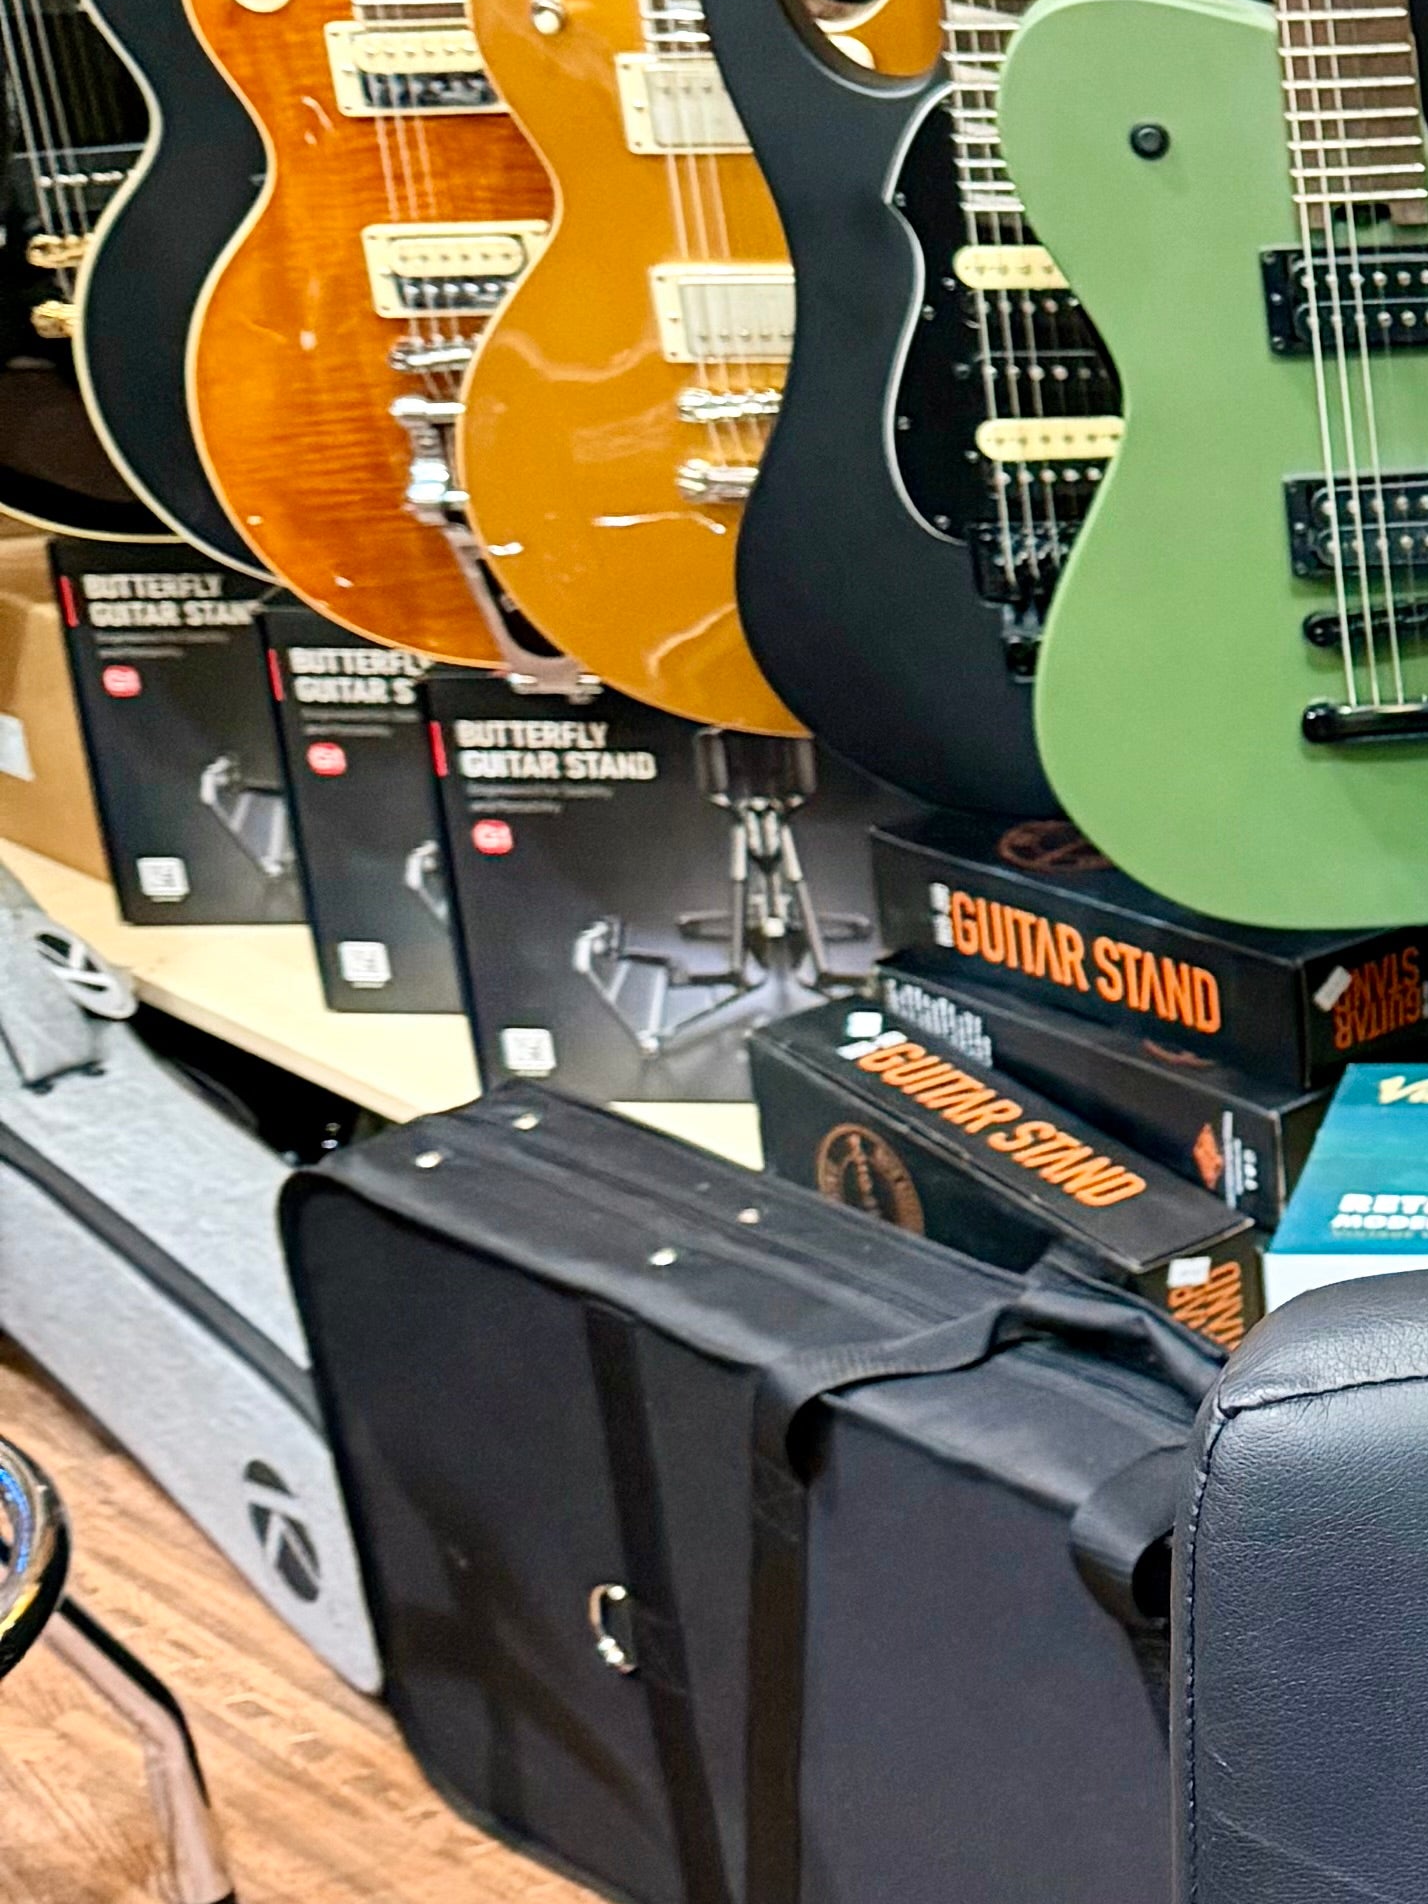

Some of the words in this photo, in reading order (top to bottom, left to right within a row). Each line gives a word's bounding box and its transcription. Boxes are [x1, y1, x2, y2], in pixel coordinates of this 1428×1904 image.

[83, 573, 224, 599] BUTTERFLY
[89, 600, 180, 627] GUITAR
[293, 676, 389, 703] GUITAR
[455, 719, 608, 749] BUTTERFLY
[460, 750, 560, 779] GUITAR
[563, 751, 657, 780] STAND
[951, 890, 1090, 993] GUITAR
[1092, 936, 1222, 1034] STAND
[858, 1040, 1023, 1134] GUITAR
[988, 1120, 1146, 1208] STAND
